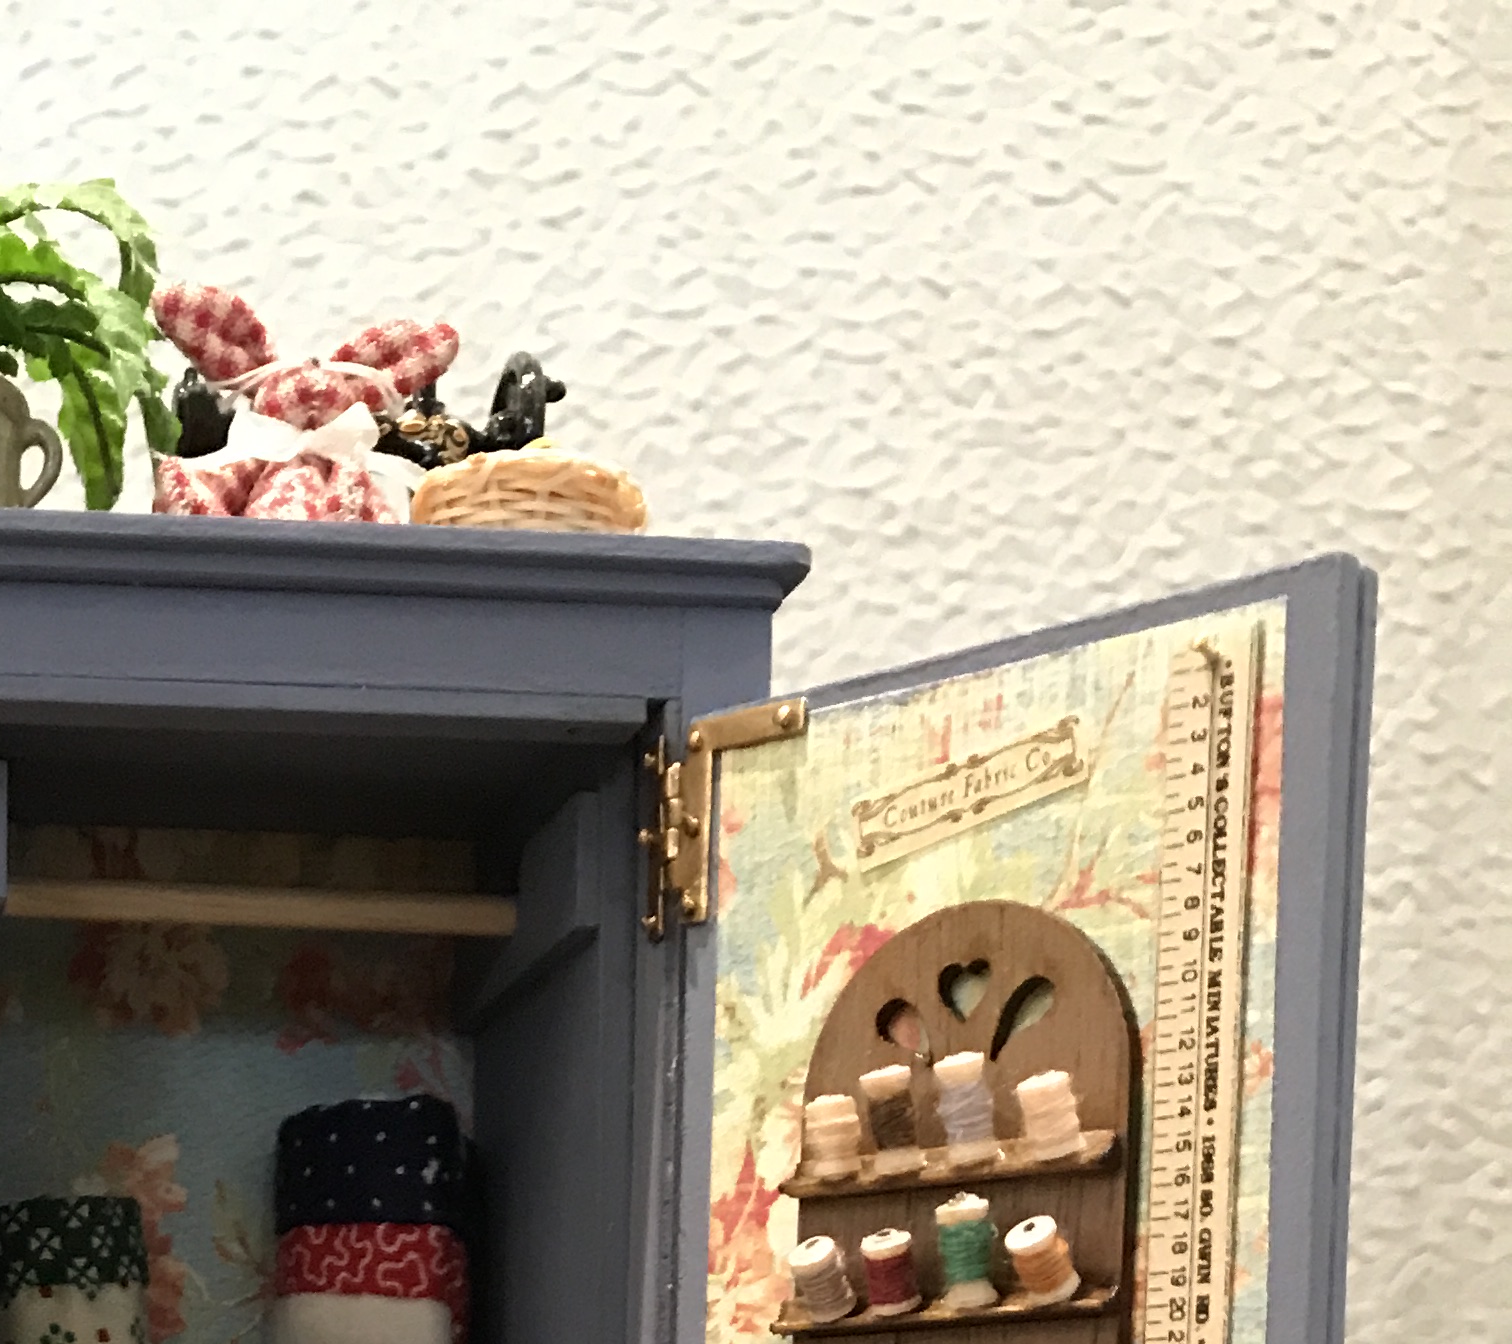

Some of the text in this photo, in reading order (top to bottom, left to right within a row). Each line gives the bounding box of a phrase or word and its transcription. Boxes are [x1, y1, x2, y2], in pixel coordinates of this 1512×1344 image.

[1192, 697, 1208, 709] 2
[1190, 729, 1208, 743] 3
[1190, 763, 1205, 775] 4
[964, 764, 1017, 798] Fabric
[1188, 796, 1204, 811] 5
[1187, 830, 1203, 844] 6
[1186, 863, 1202, 875] 7
[1208, 800, 1229, 962] COLLECTABLE
[1184, 896, 1201, 909] 8
[1183, 928, 1199, 941] 9
[1181, 960, 1198, 982] 10
[1180, 994, 1196, 1014] 11
[1178, 1027, 1195, 1050] 12
[1204, 969, 1222, 1112] MINIATURES
[1177, 1063, 1194, 1085] 13
[1177, 1095, 1194, 1117] 14
[1175, 1131, 1192, 1152] 15
[1174, 1165, 1191, 1186] 16
[1173, 1200, 1189, 1220] 17
[1171, 1232, 1188, 1254] 18
[1170, 1265, 1186, 1288] 19
[1169, 1298, 1186, 1320] 20
